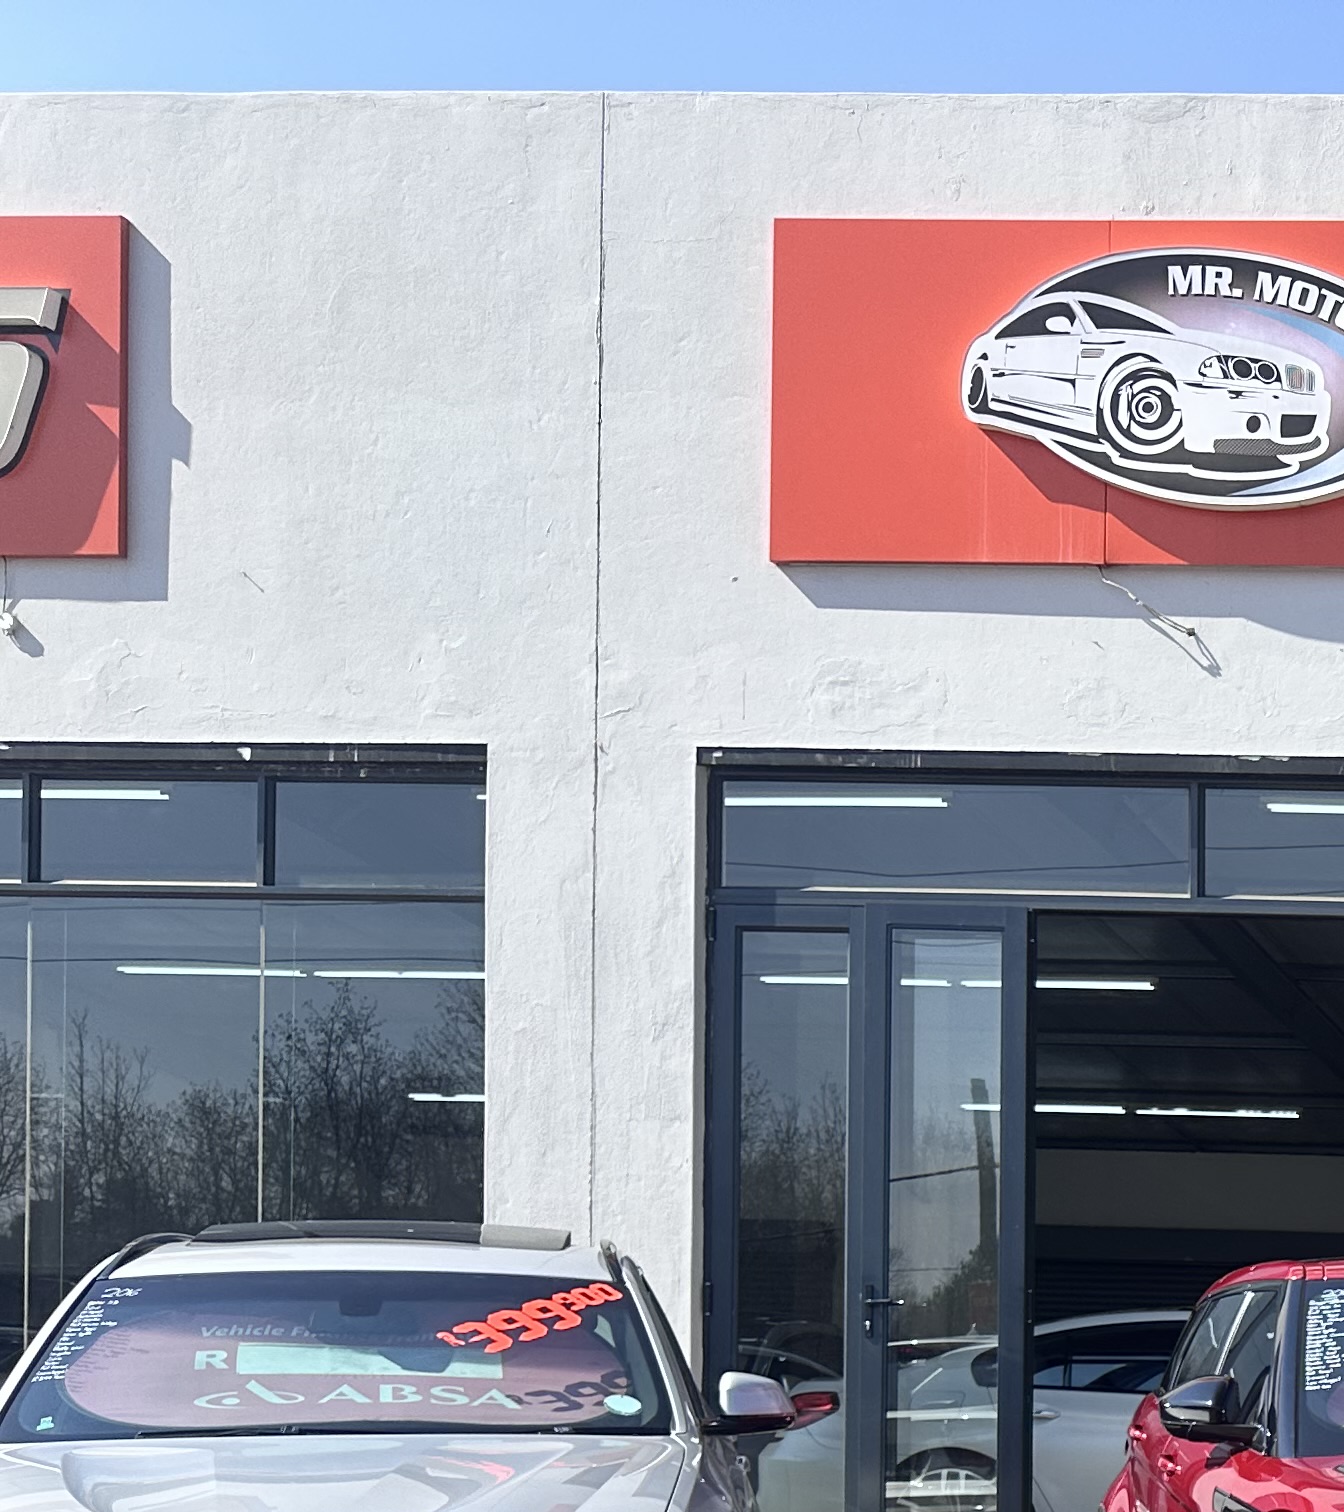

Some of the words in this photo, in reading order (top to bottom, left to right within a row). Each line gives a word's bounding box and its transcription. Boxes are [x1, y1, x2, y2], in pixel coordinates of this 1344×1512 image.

[1167, 263, 1243, 299] MR.
[201, 1324, 285, 1338] Vehicle
[194, 1349, 229, 1371] R
[317, 1383, 523, 1410] ABSA
